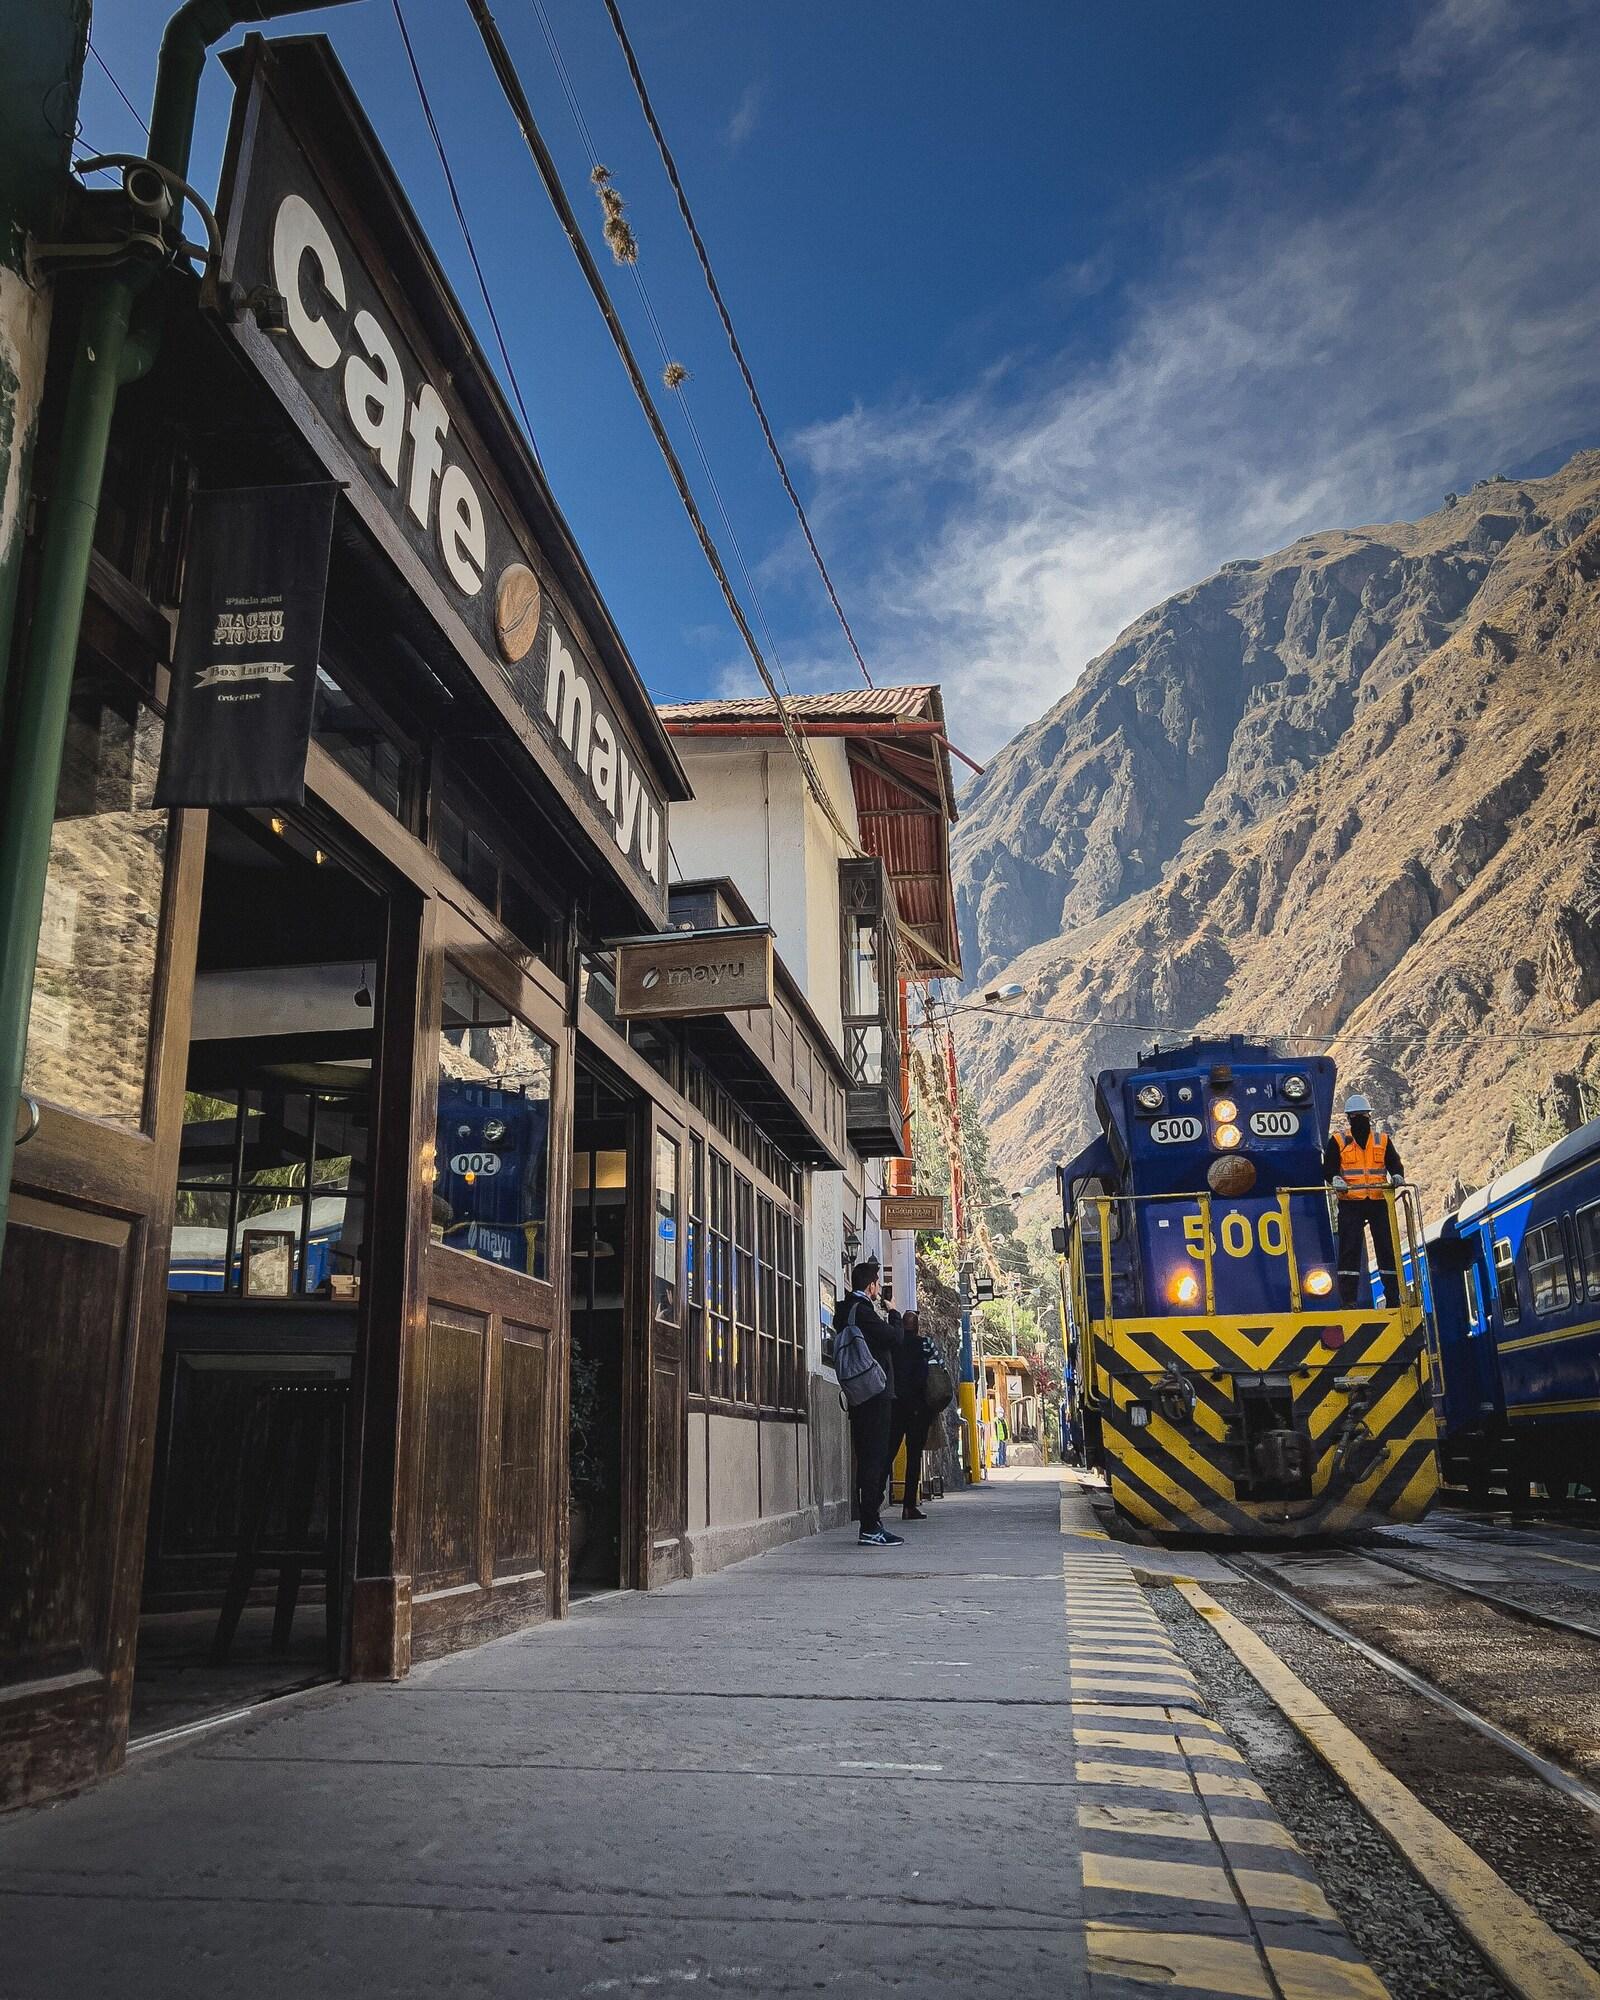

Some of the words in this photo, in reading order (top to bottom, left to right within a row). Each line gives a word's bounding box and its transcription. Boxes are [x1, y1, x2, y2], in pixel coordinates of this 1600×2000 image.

[217, 610, 285, 628] MACHU
[212, 626, 285, 645] PICCHU
[209, 666, 237, 677] Box
[241, 663, 281, 676] Lunch
[544, 623, 661, 886] mayu
[666, 962, 745, 985] mayu
[1157, 1119, 1195, 1141] 500
[1256, 1113, 1292, 1133] 500
[479, 1227, 511, 1259] mayu
[1183, 1211, 1288, 1260] 500
